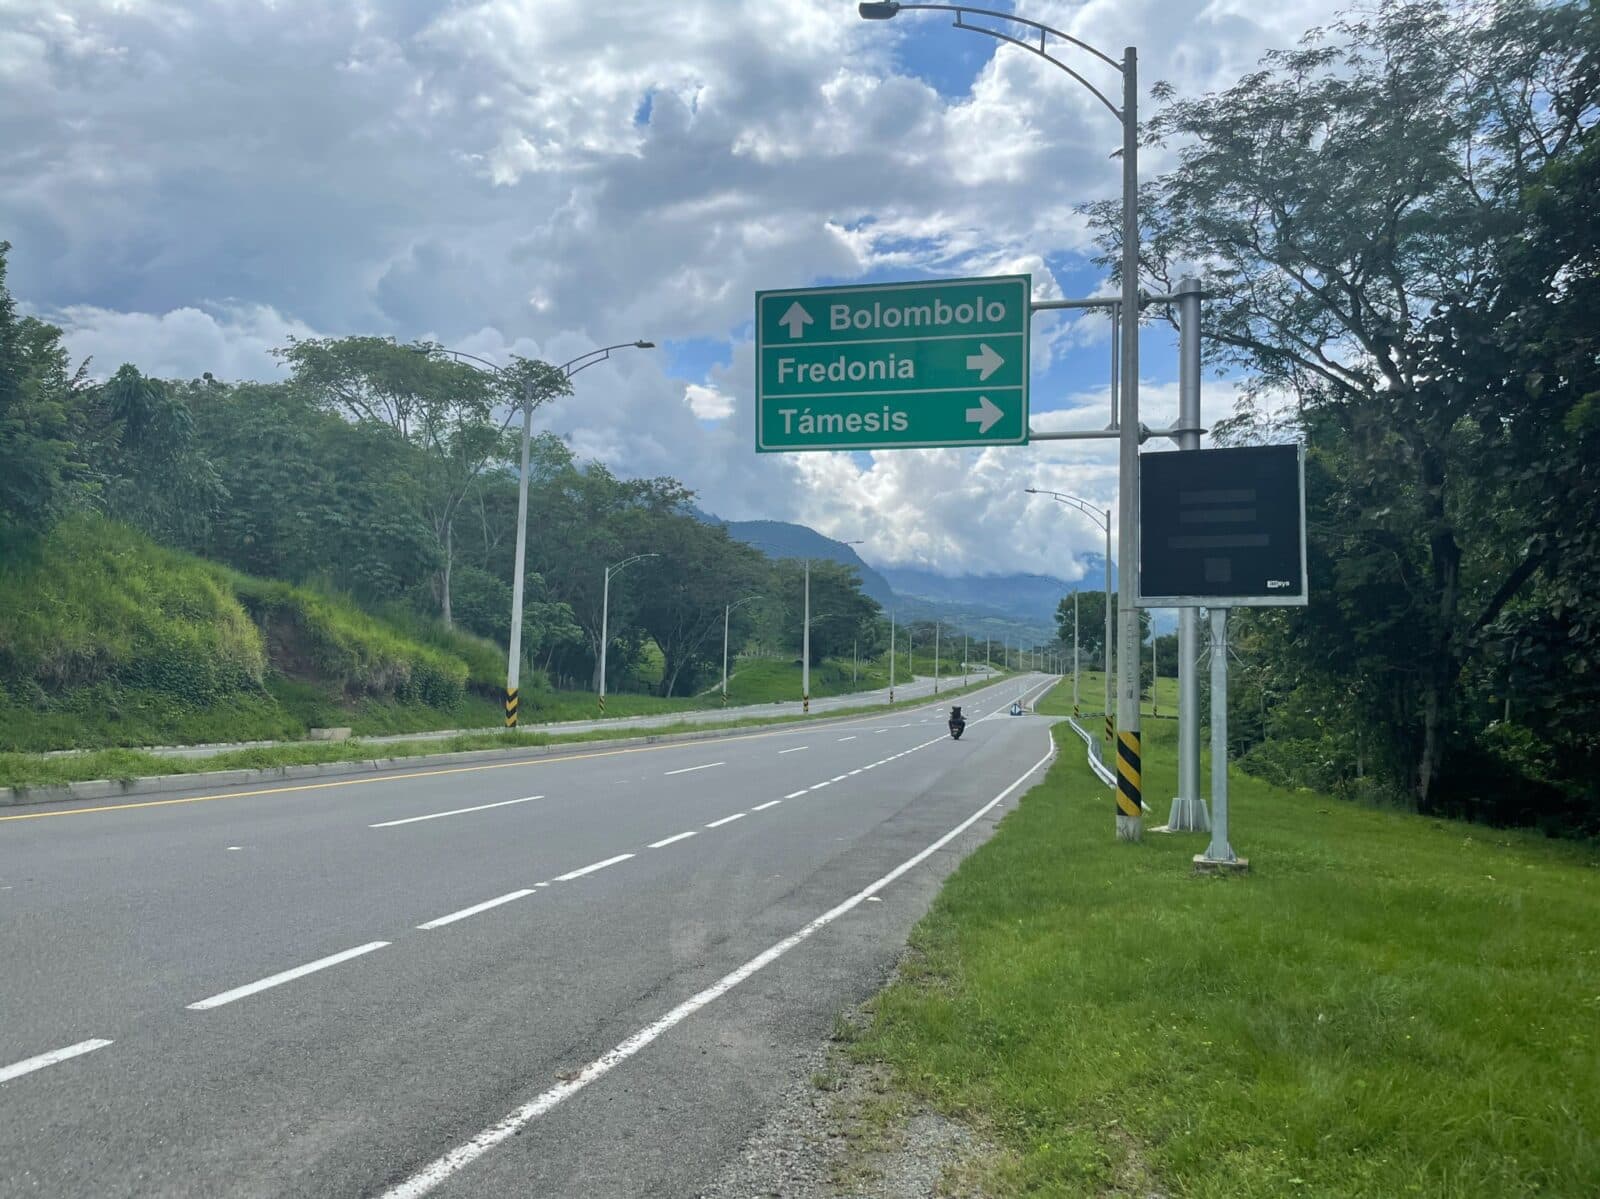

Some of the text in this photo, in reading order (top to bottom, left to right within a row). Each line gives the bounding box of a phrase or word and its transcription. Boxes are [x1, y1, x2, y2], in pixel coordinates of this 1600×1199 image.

[829, 296, 1006, 330] Bolombolo
[777, 353, 915, 384] Fredonia
[778, 406, 909, 434] Támesis
